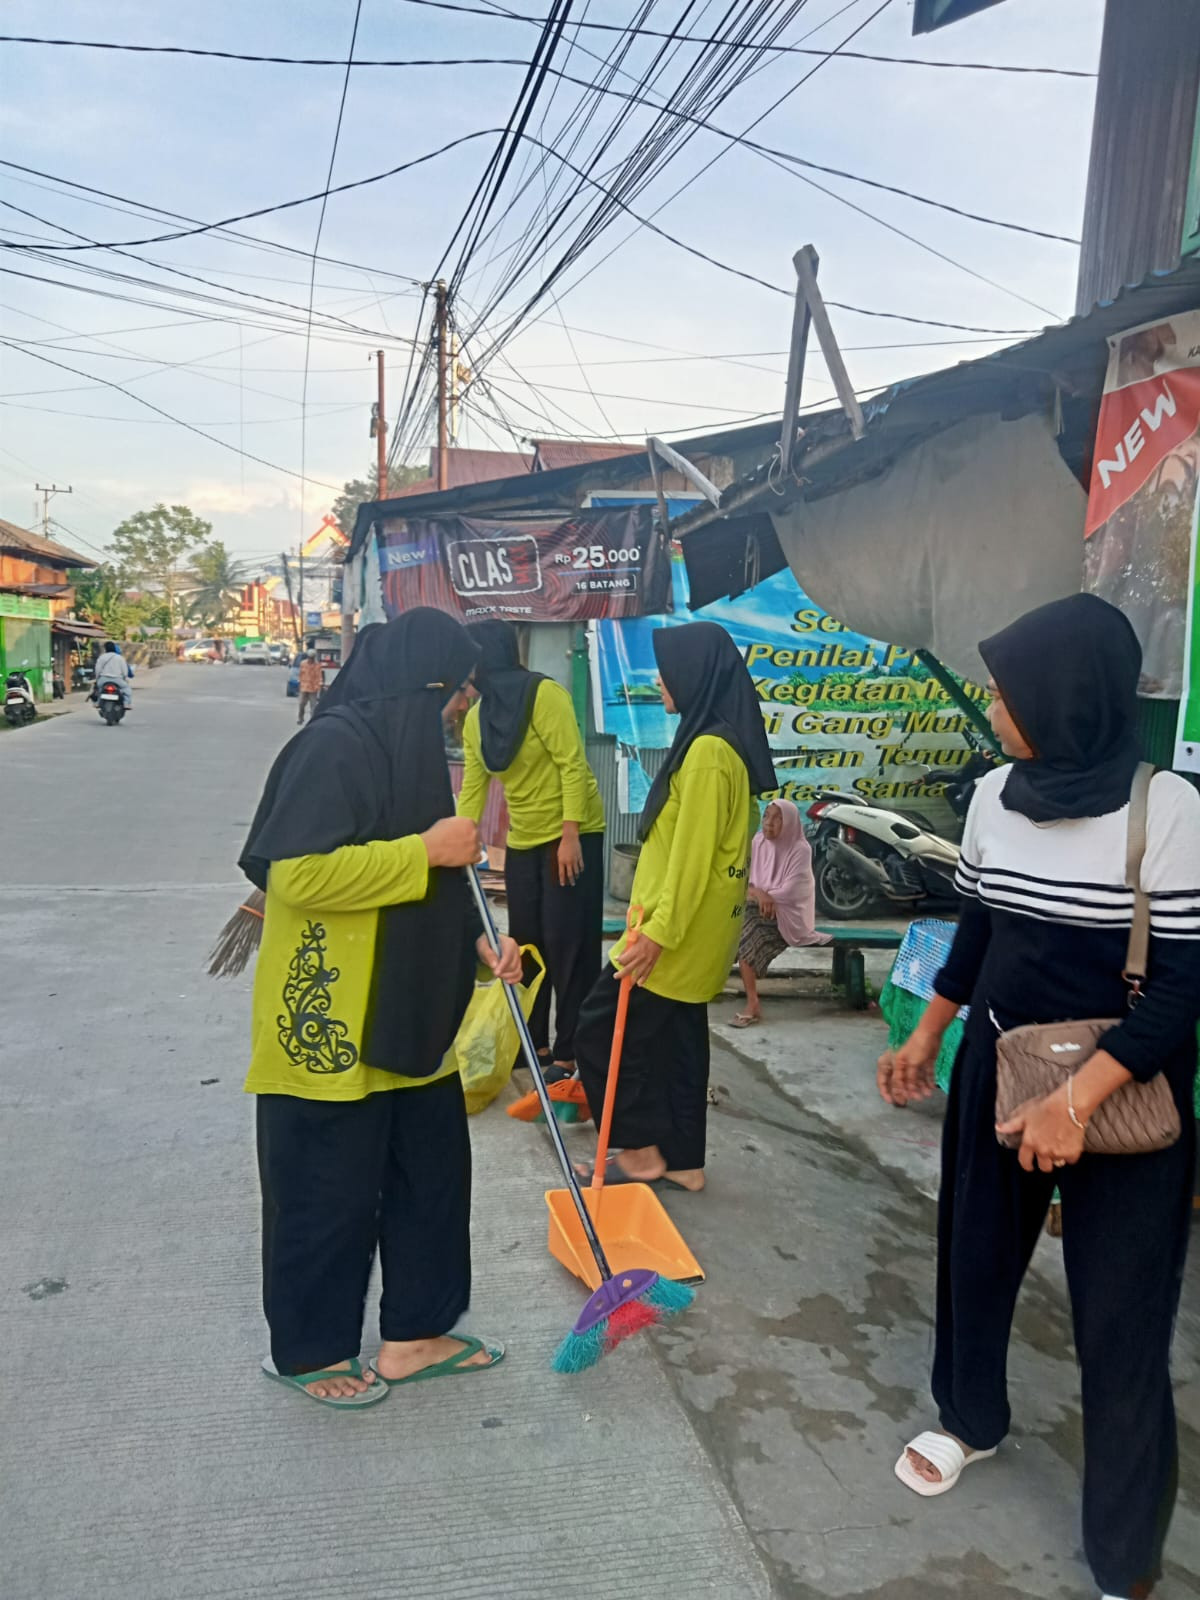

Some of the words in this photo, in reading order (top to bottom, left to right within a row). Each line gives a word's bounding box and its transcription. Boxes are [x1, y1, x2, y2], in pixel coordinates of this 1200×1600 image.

[1097, 379, 1177, 489] NEW
[387, 549, 426, 565] New
[458, 547, 513, 589] CLAS
[554, 553, 571, 565] Rp
[575, 582, 587, 590] 16
[589, 579, 631, 589] BATANG
[465, 606, 496, 616] MAXX
[791, 609, 850, 632] Se
[745, 643, 876, 668] Penilai
[754, 679, 911, 707] Kegiatan
[792, 711, 894, 740] Gang
